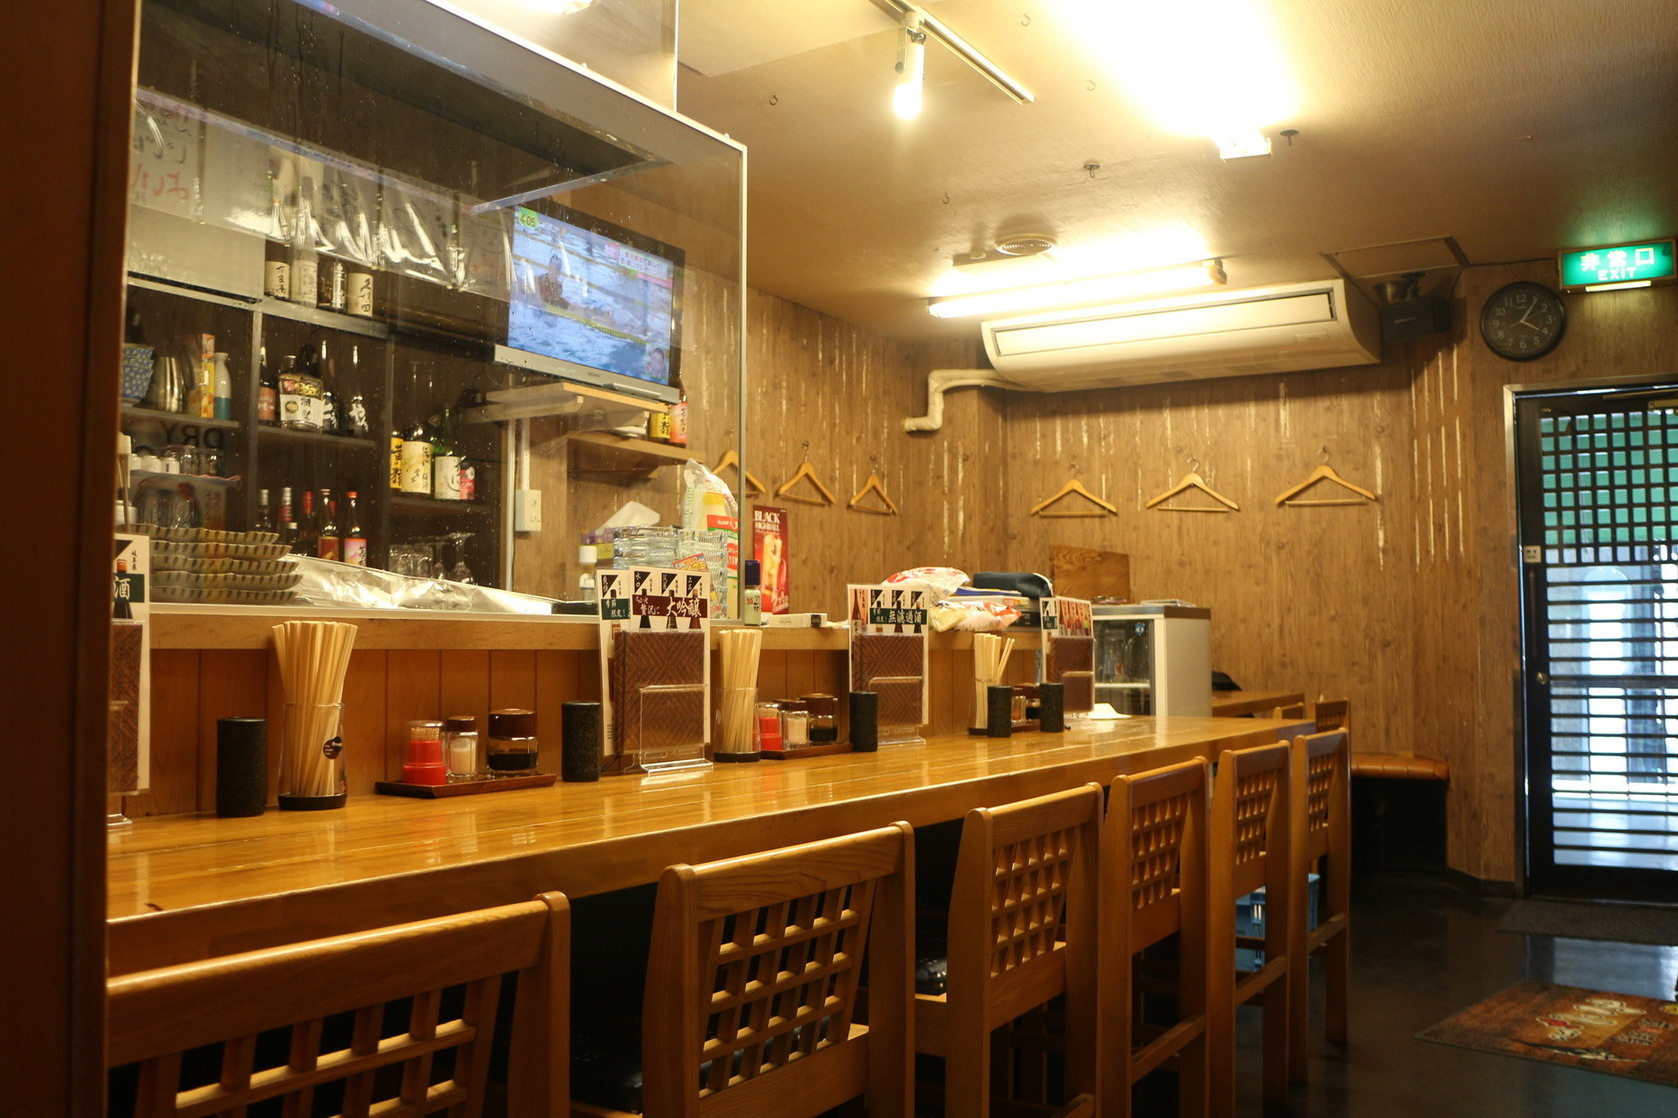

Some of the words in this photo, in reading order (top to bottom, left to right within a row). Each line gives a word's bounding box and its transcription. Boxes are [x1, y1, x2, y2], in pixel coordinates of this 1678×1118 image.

[1580, 247, 1655, 272] 非常口
[1597, 267, 1637, 281] EXIT
[1504, 297, 1513, 307] 11
[1516, 293, 1527, 303] 12
[1495, 307, 1506, 316] 10
[1541, 304, 1548, 312] 2
[1545, 315, 1553, 324] 3
[1493, 320, 1500, 329] 9
[1497, 330, 1505, 339] 8
[1541, 327, 1548, 335] 4
[1507, 338, 1514, 347] 7
[1519, 339, 1527, 349] 6
[1533, 336, 1540, 345] 5
[754, 510, 780, 524] BLACK
[666, 597, 702, 618] 大吟醸
